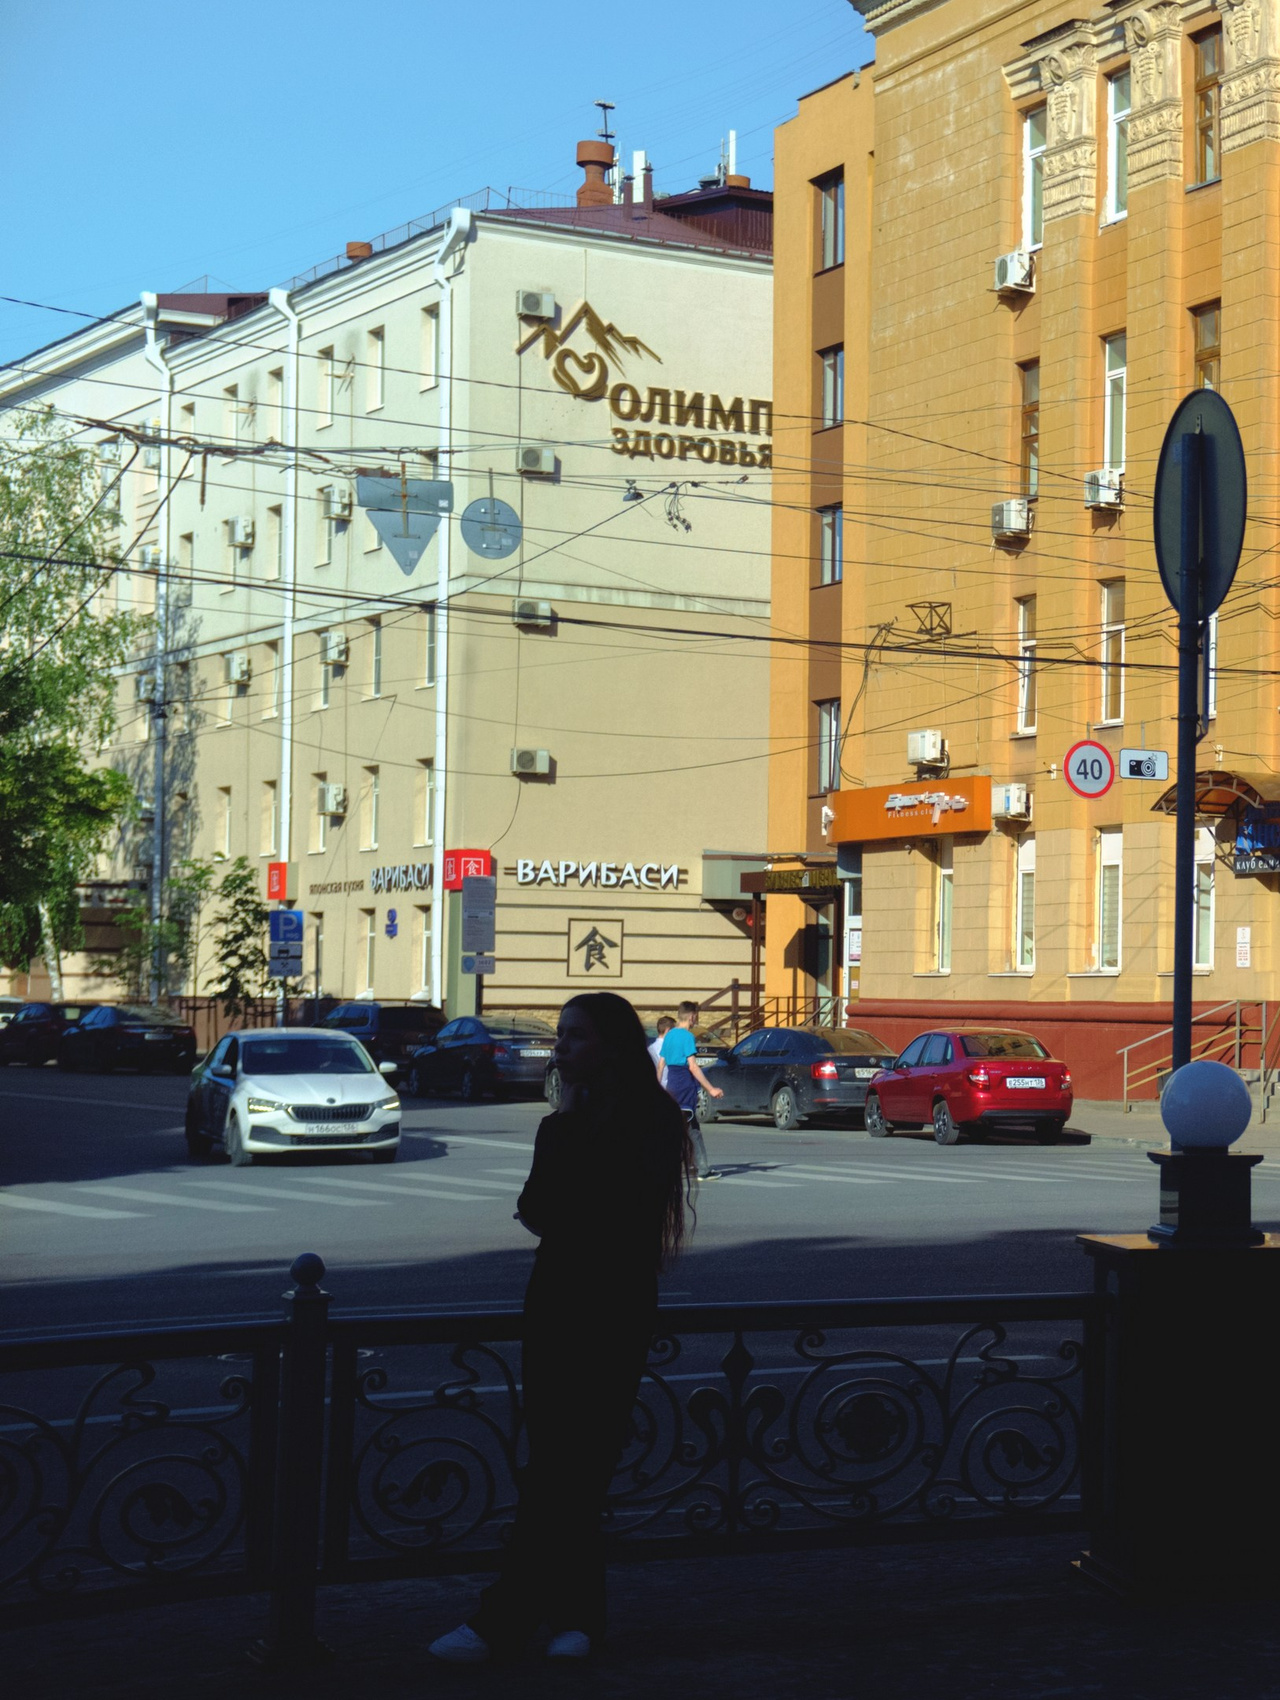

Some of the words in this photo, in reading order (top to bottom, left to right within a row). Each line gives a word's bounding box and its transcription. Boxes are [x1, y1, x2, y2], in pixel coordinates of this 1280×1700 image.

[608, 382, 773, 437] ОЛИМП
[610, 427, 773, 470] ЗДОРОВЬЯ
[1076, 758, 1103, 780] 40
[371, 863, 431, 891] ВАРИБАСИ
[516, 859, 679, 889] ВАРИБАСИ
[1236, 857, 1256, 874] клуб
